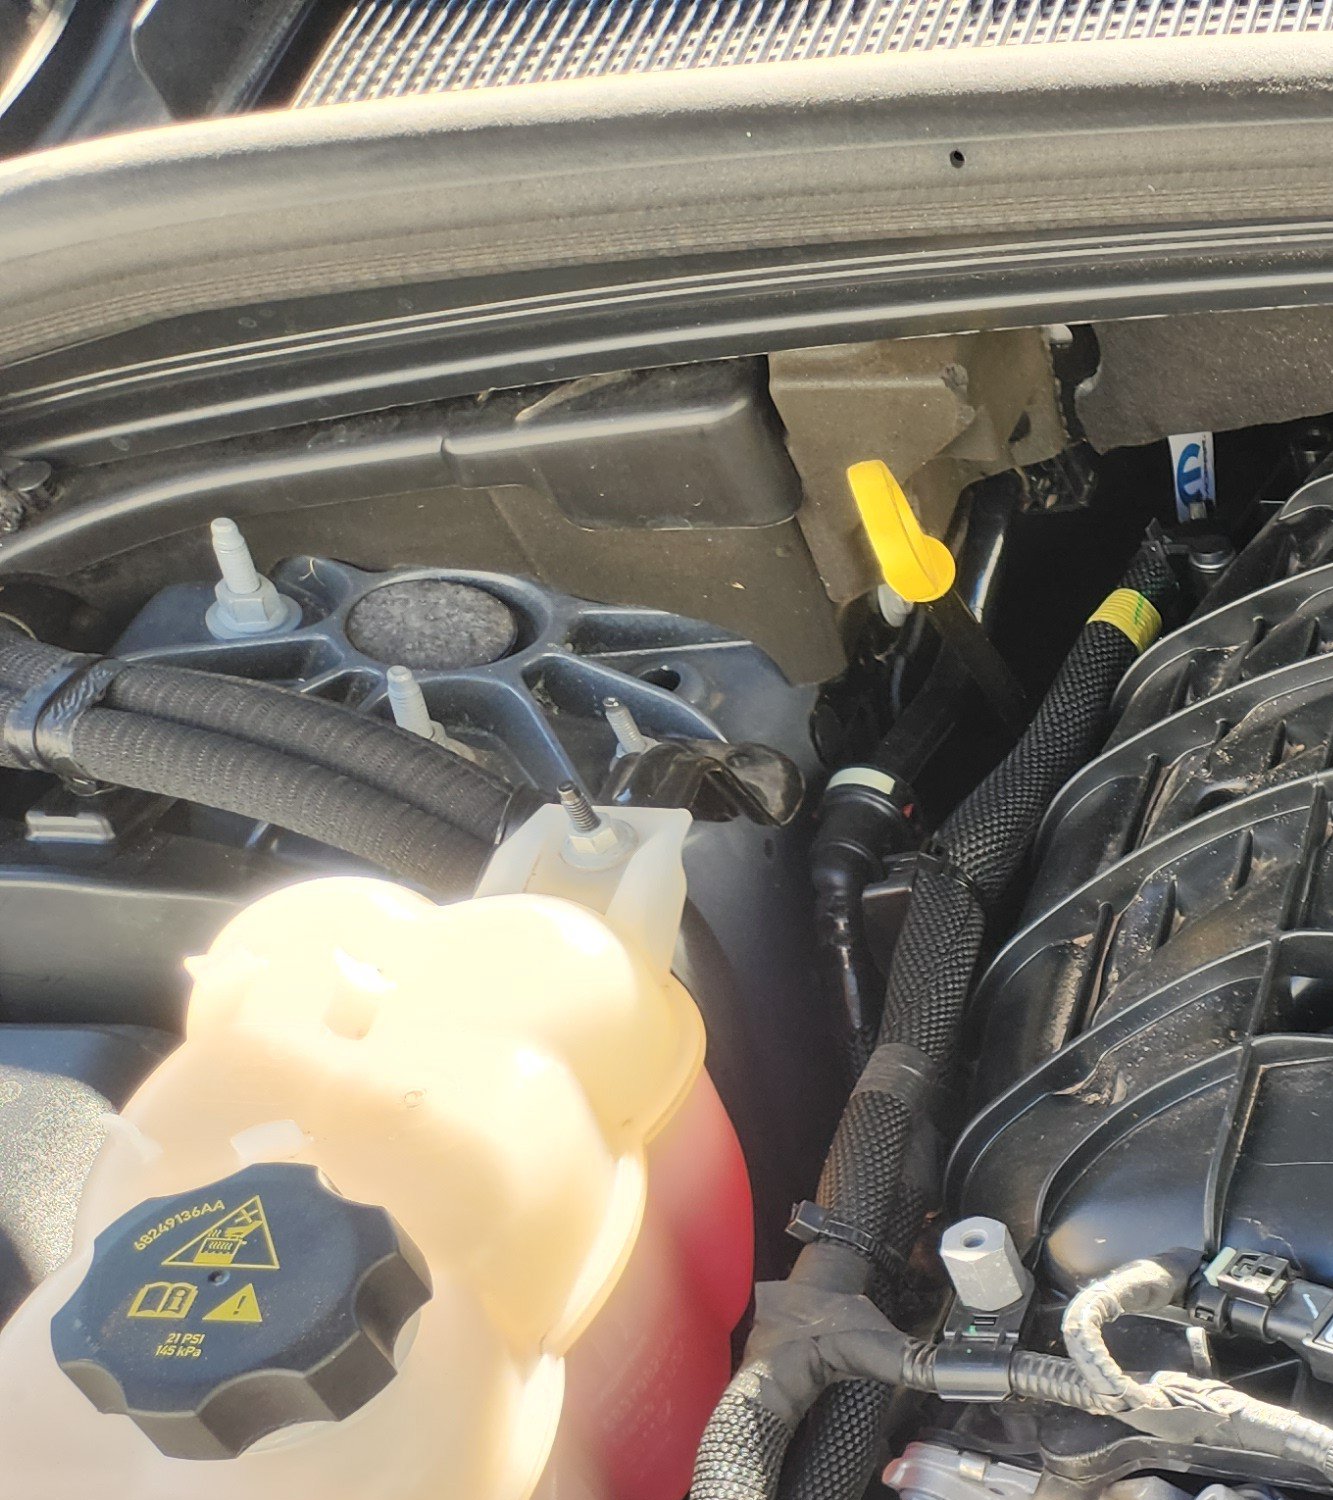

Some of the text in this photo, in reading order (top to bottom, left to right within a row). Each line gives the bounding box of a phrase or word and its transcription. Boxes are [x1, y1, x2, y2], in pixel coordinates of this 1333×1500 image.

[133, 1199, 226, 1252] 68249136AA
[166, 1332, 206, 1345] 21 PSI
[154, 1344, 203, 1358] 145 kPa
